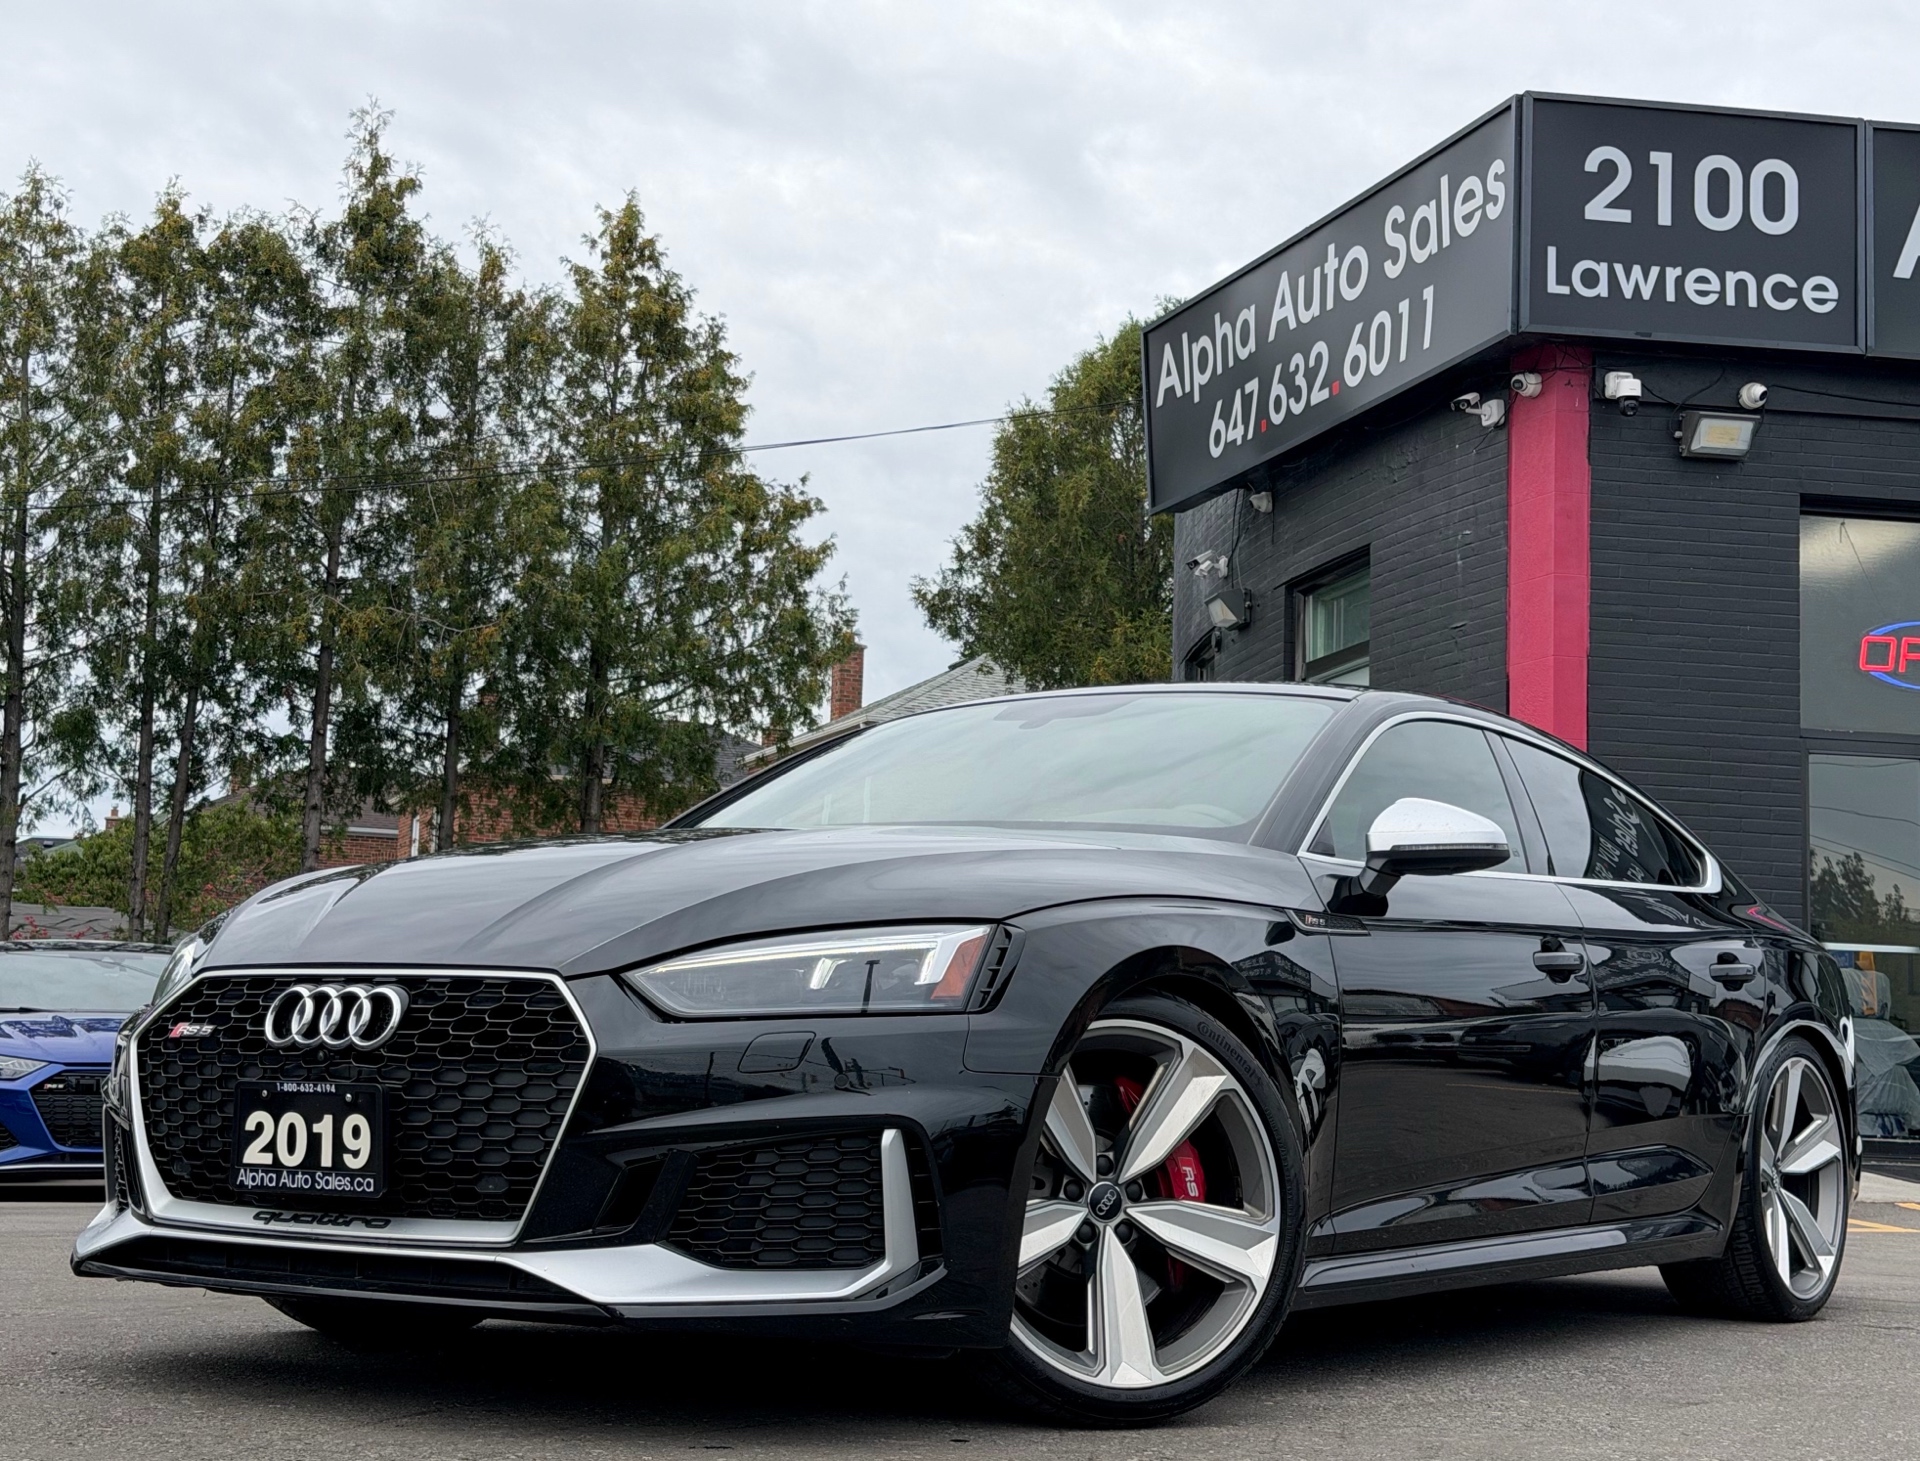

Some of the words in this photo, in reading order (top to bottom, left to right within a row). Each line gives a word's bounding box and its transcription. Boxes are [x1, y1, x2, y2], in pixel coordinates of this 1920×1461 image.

[1584, 145, 1799, 235] 2100
[1156, 303, 1256, 408] Alpha
[1268, 242, 1369, 343] Auto
[1383, 158, 1506, 279] Sales
[1547, 245, 1839, 314] Lawrence
[1208, 284, 1434, 459] 647.632.6011
[277, 1083, 336, 1093] 1-800-632-4194
[242, 1110, 371, 1169] 2019
[237, 1168, 276, 1189] Alpha
[279, 1170, 312, 1189] Auto
[315, 1172, 374, 1192] Sales.ca
[1182, 1166, 1199, 1197] RS
[252, 1210, 391, 1229] quattro
